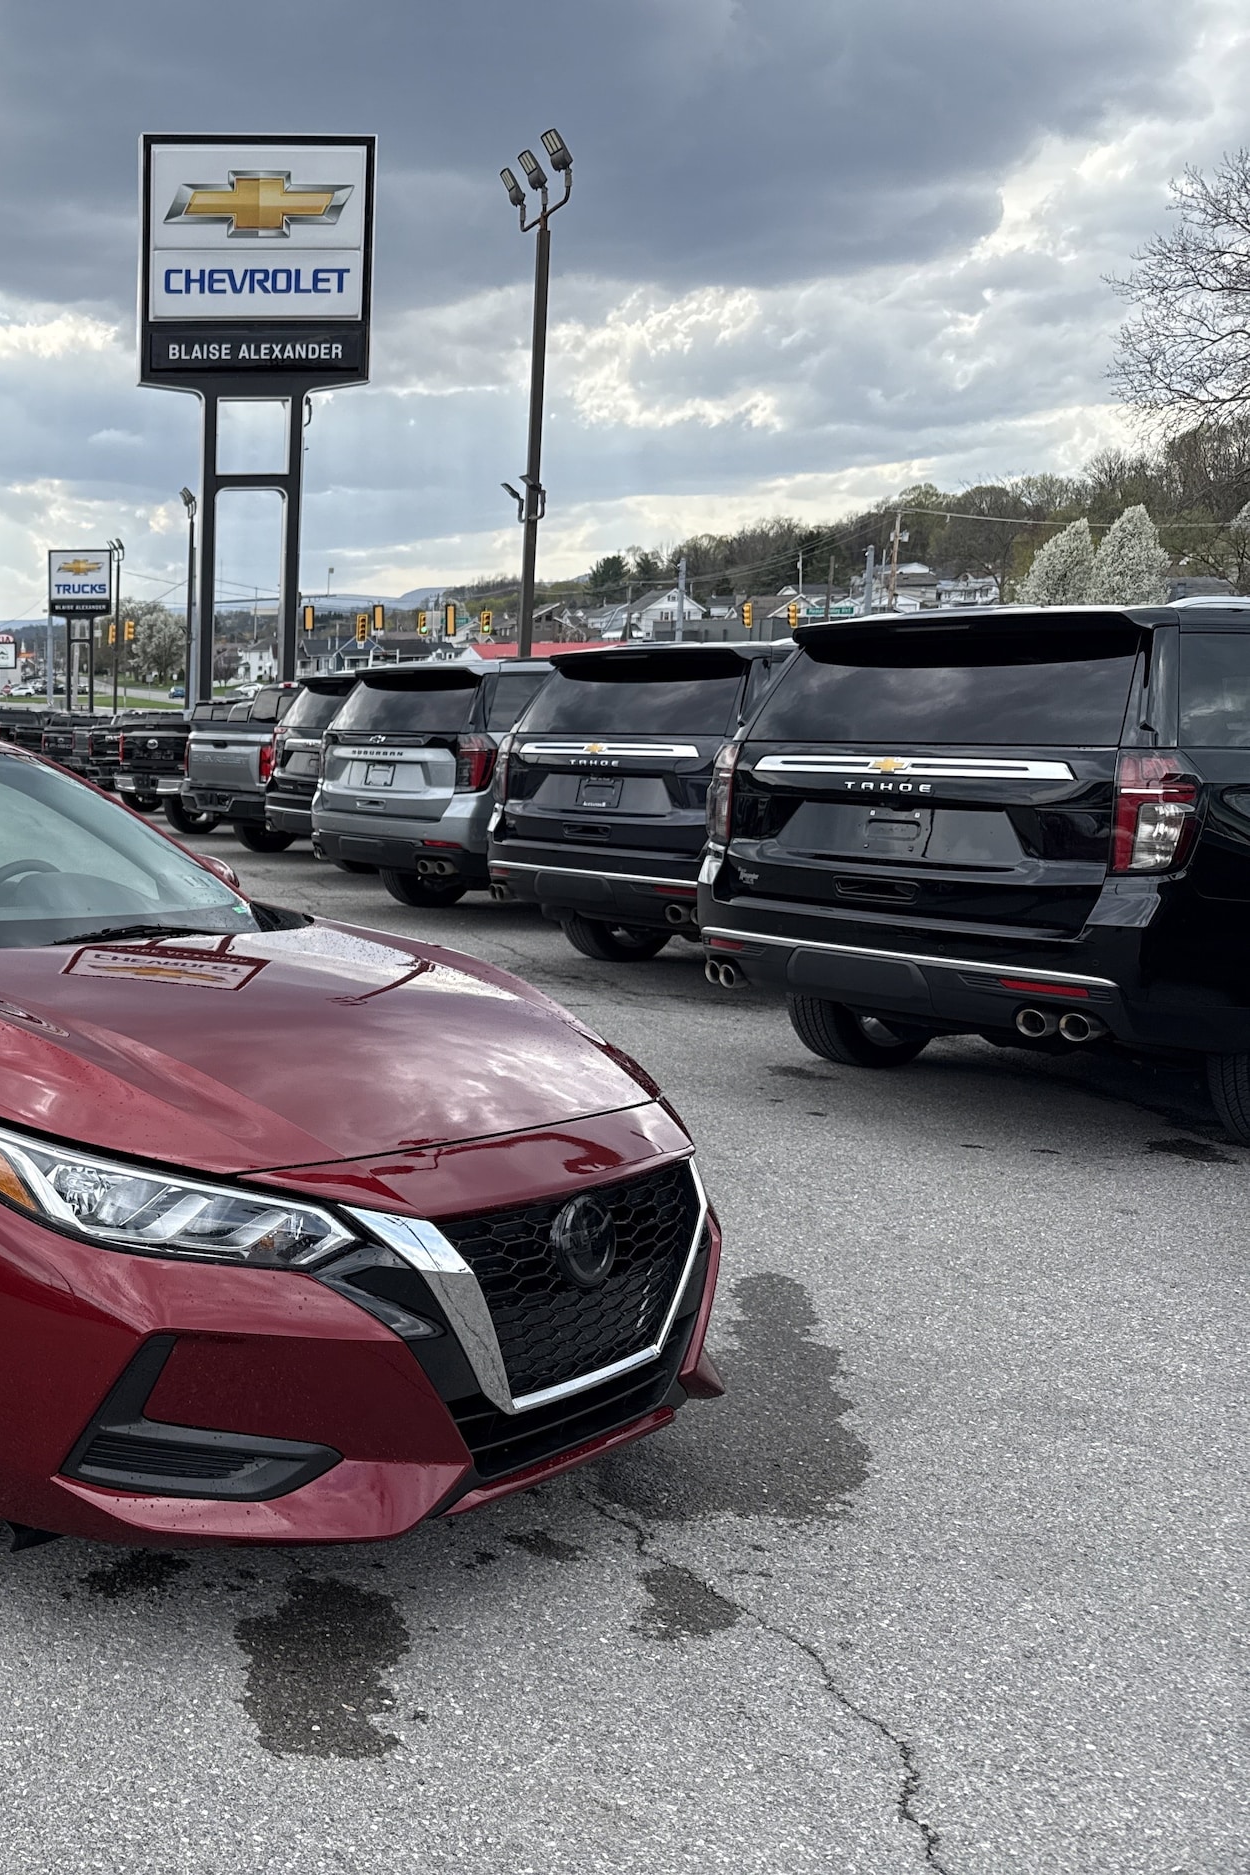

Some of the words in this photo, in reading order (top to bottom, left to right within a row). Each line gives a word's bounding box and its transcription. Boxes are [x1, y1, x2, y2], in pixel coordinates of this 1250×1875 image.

[164, 268, 350, 294] CHEVROLET
[168, 344, 231, 360] BLAISE
[238, 343, 343, 360] ALEXANDER
[54, 584, 107, 594] TRUCKS
[570, 759, 619, 768] TAHOE
[844, 781, 932, 793] TAHOE
